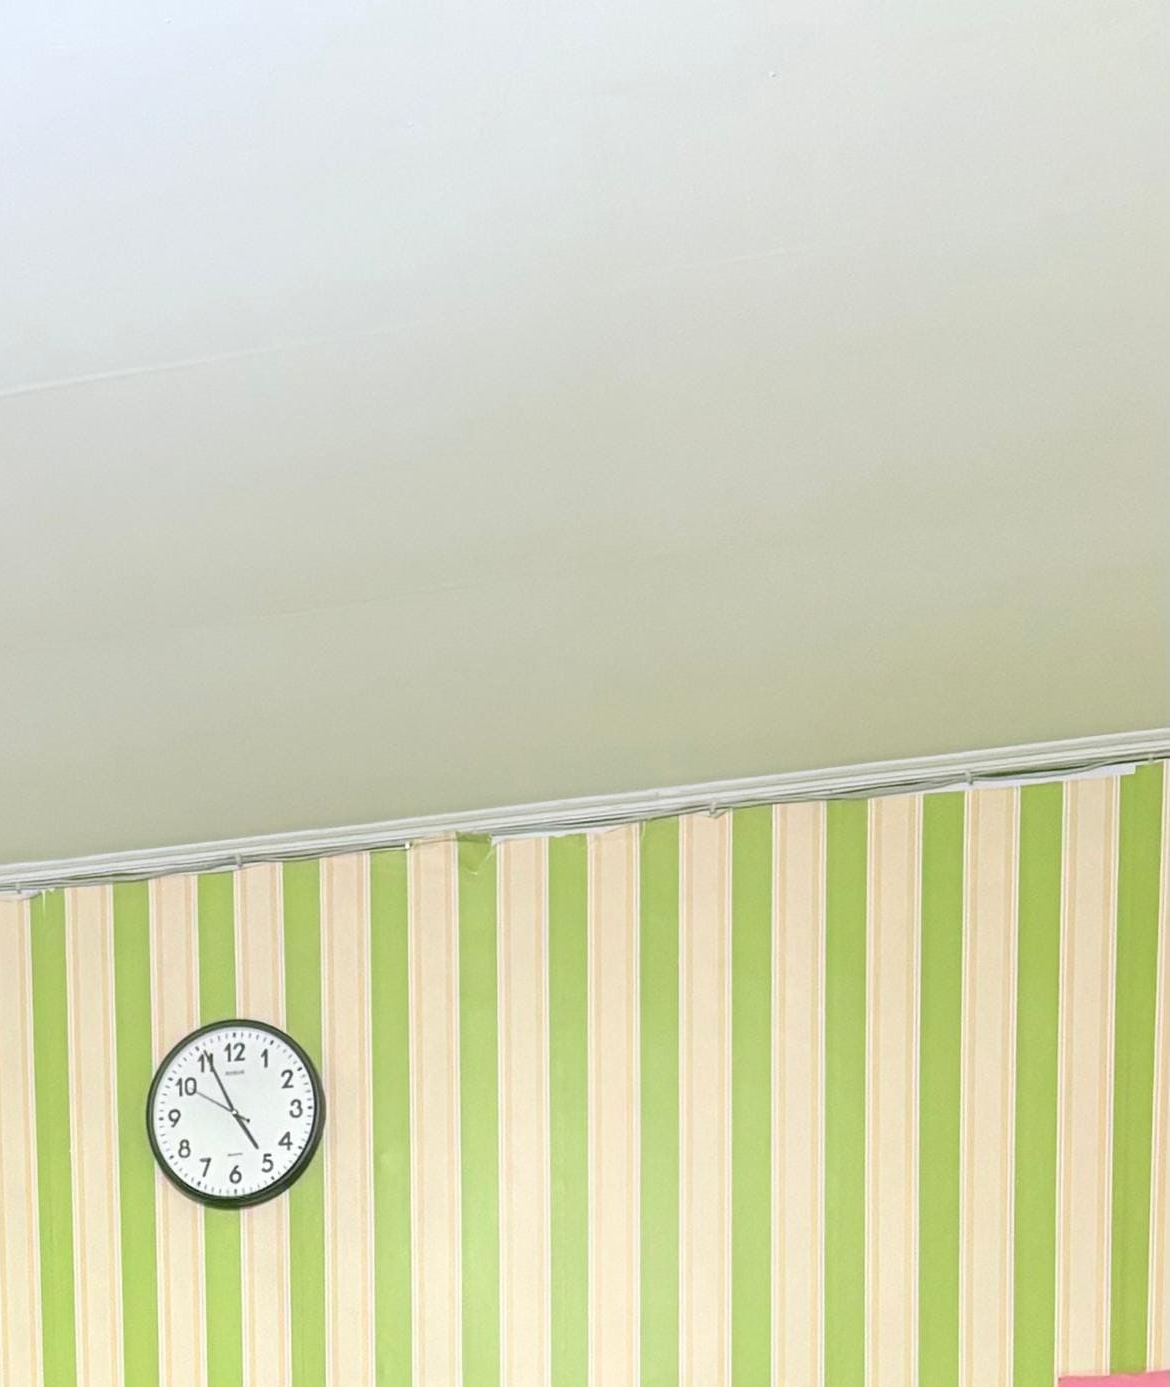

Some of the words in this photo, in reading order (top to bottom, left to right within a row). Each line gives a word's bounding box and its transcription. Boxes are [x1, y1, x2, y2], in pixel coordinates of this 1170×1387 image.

[224, 1043, 245, 1062] 12
[261, 1049, 268, 1068] 1
[198, 1053, 214, 1073] 11
[175, 1077, 197, 1097] 10
[281, 1069, 294, 1089] 2
[289, 1099, 303, 1118] 3
[168, 1109, 181, 1128] 9
[178, 1139, 191, 1158] 8
[278, 1131, 293, 1150] 4
[199, 1158, 212, 1177] 7
[261, 1154, 274, 1172] 5
[230, 1165, 242, 1184] 6
